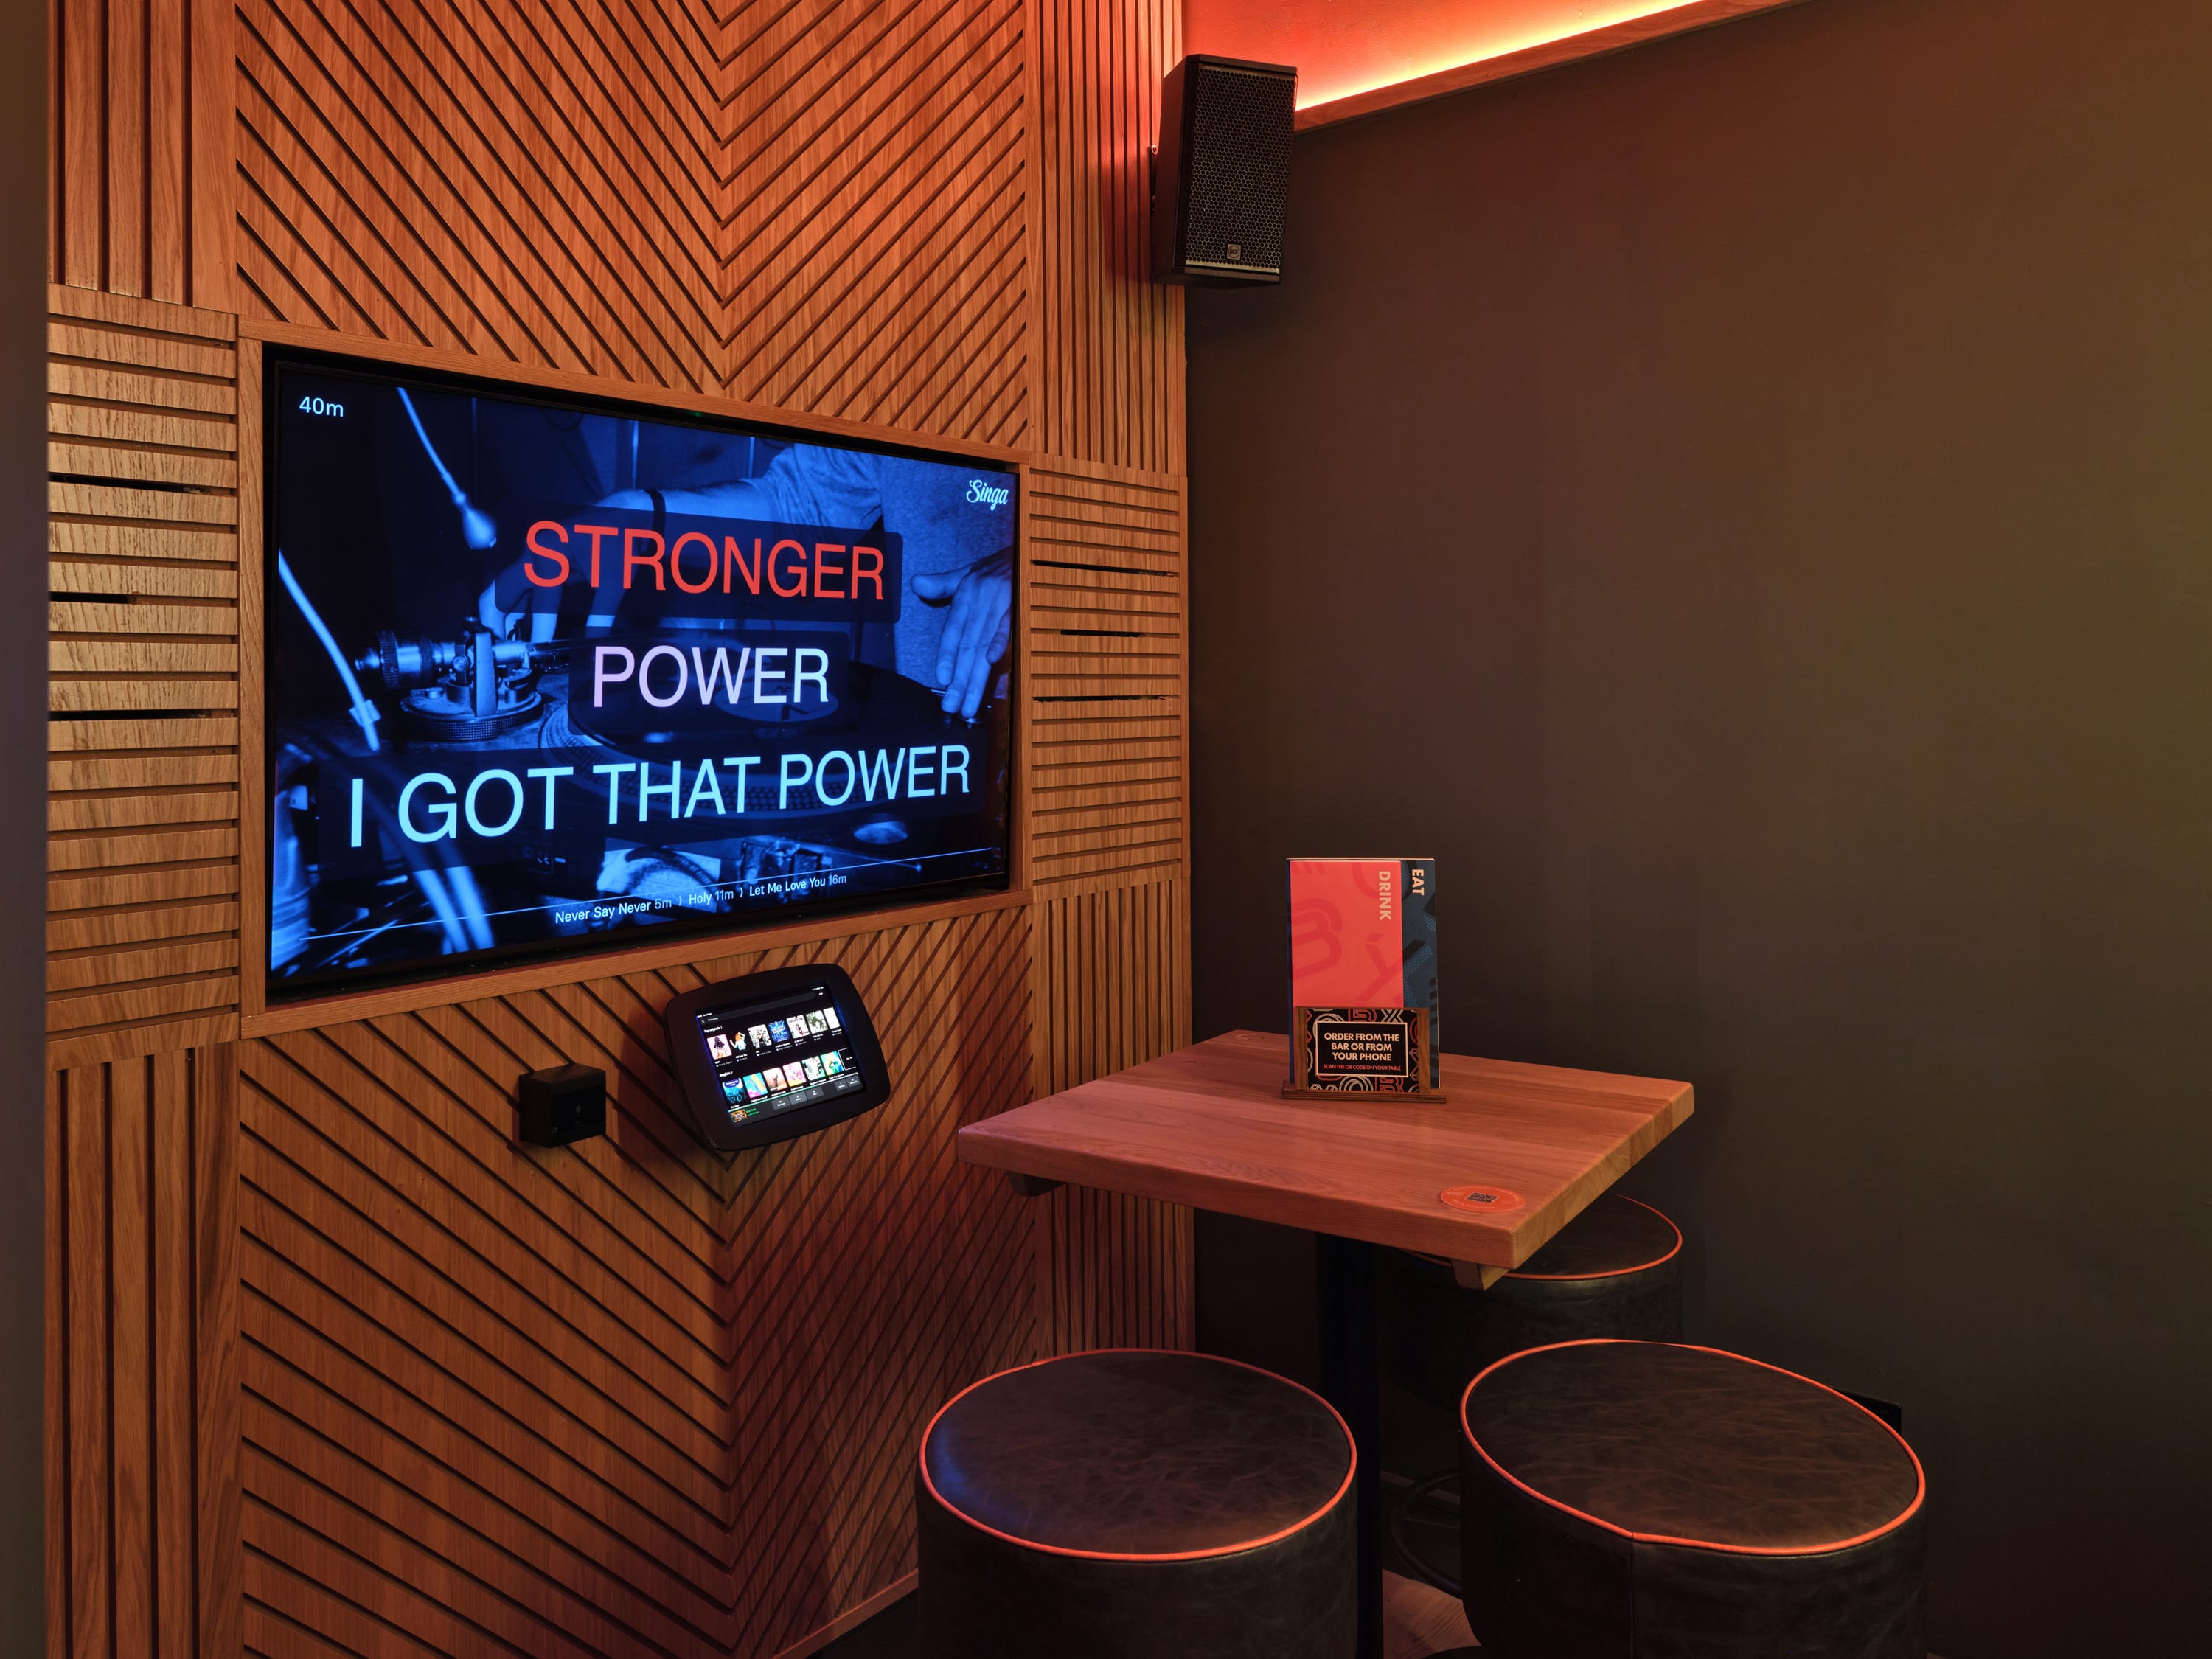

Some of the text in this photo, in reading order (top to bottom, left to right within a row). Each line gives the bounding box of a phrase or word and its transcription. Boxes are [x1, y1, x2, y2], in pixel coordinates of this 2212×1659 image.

[299, 397, 344, 417] 40m
[966, 479, 1009, 511] Singa
[524, 520, 883, 600] STRONGER
[593, 645, 829, 708] POWER
[351, 745, 970, 848] I GOT THAT POWER
[749, 874, 847, 897] Let Me Love You 16m
[1412, 869, 1425, 896] EAT
[689, 890, 734, 905] Holy 11m
[1379, 871, 1392, 920] DRINK
[555, 899, 672, 924] Never Say Never 5m
[1324, 1032, 1399, 1042] ORDER FROM THE
[1331, 1042, 1392, 1051] BAR OR FROM
[1332, 1052, 1392, 1061] YOUR PHONE
